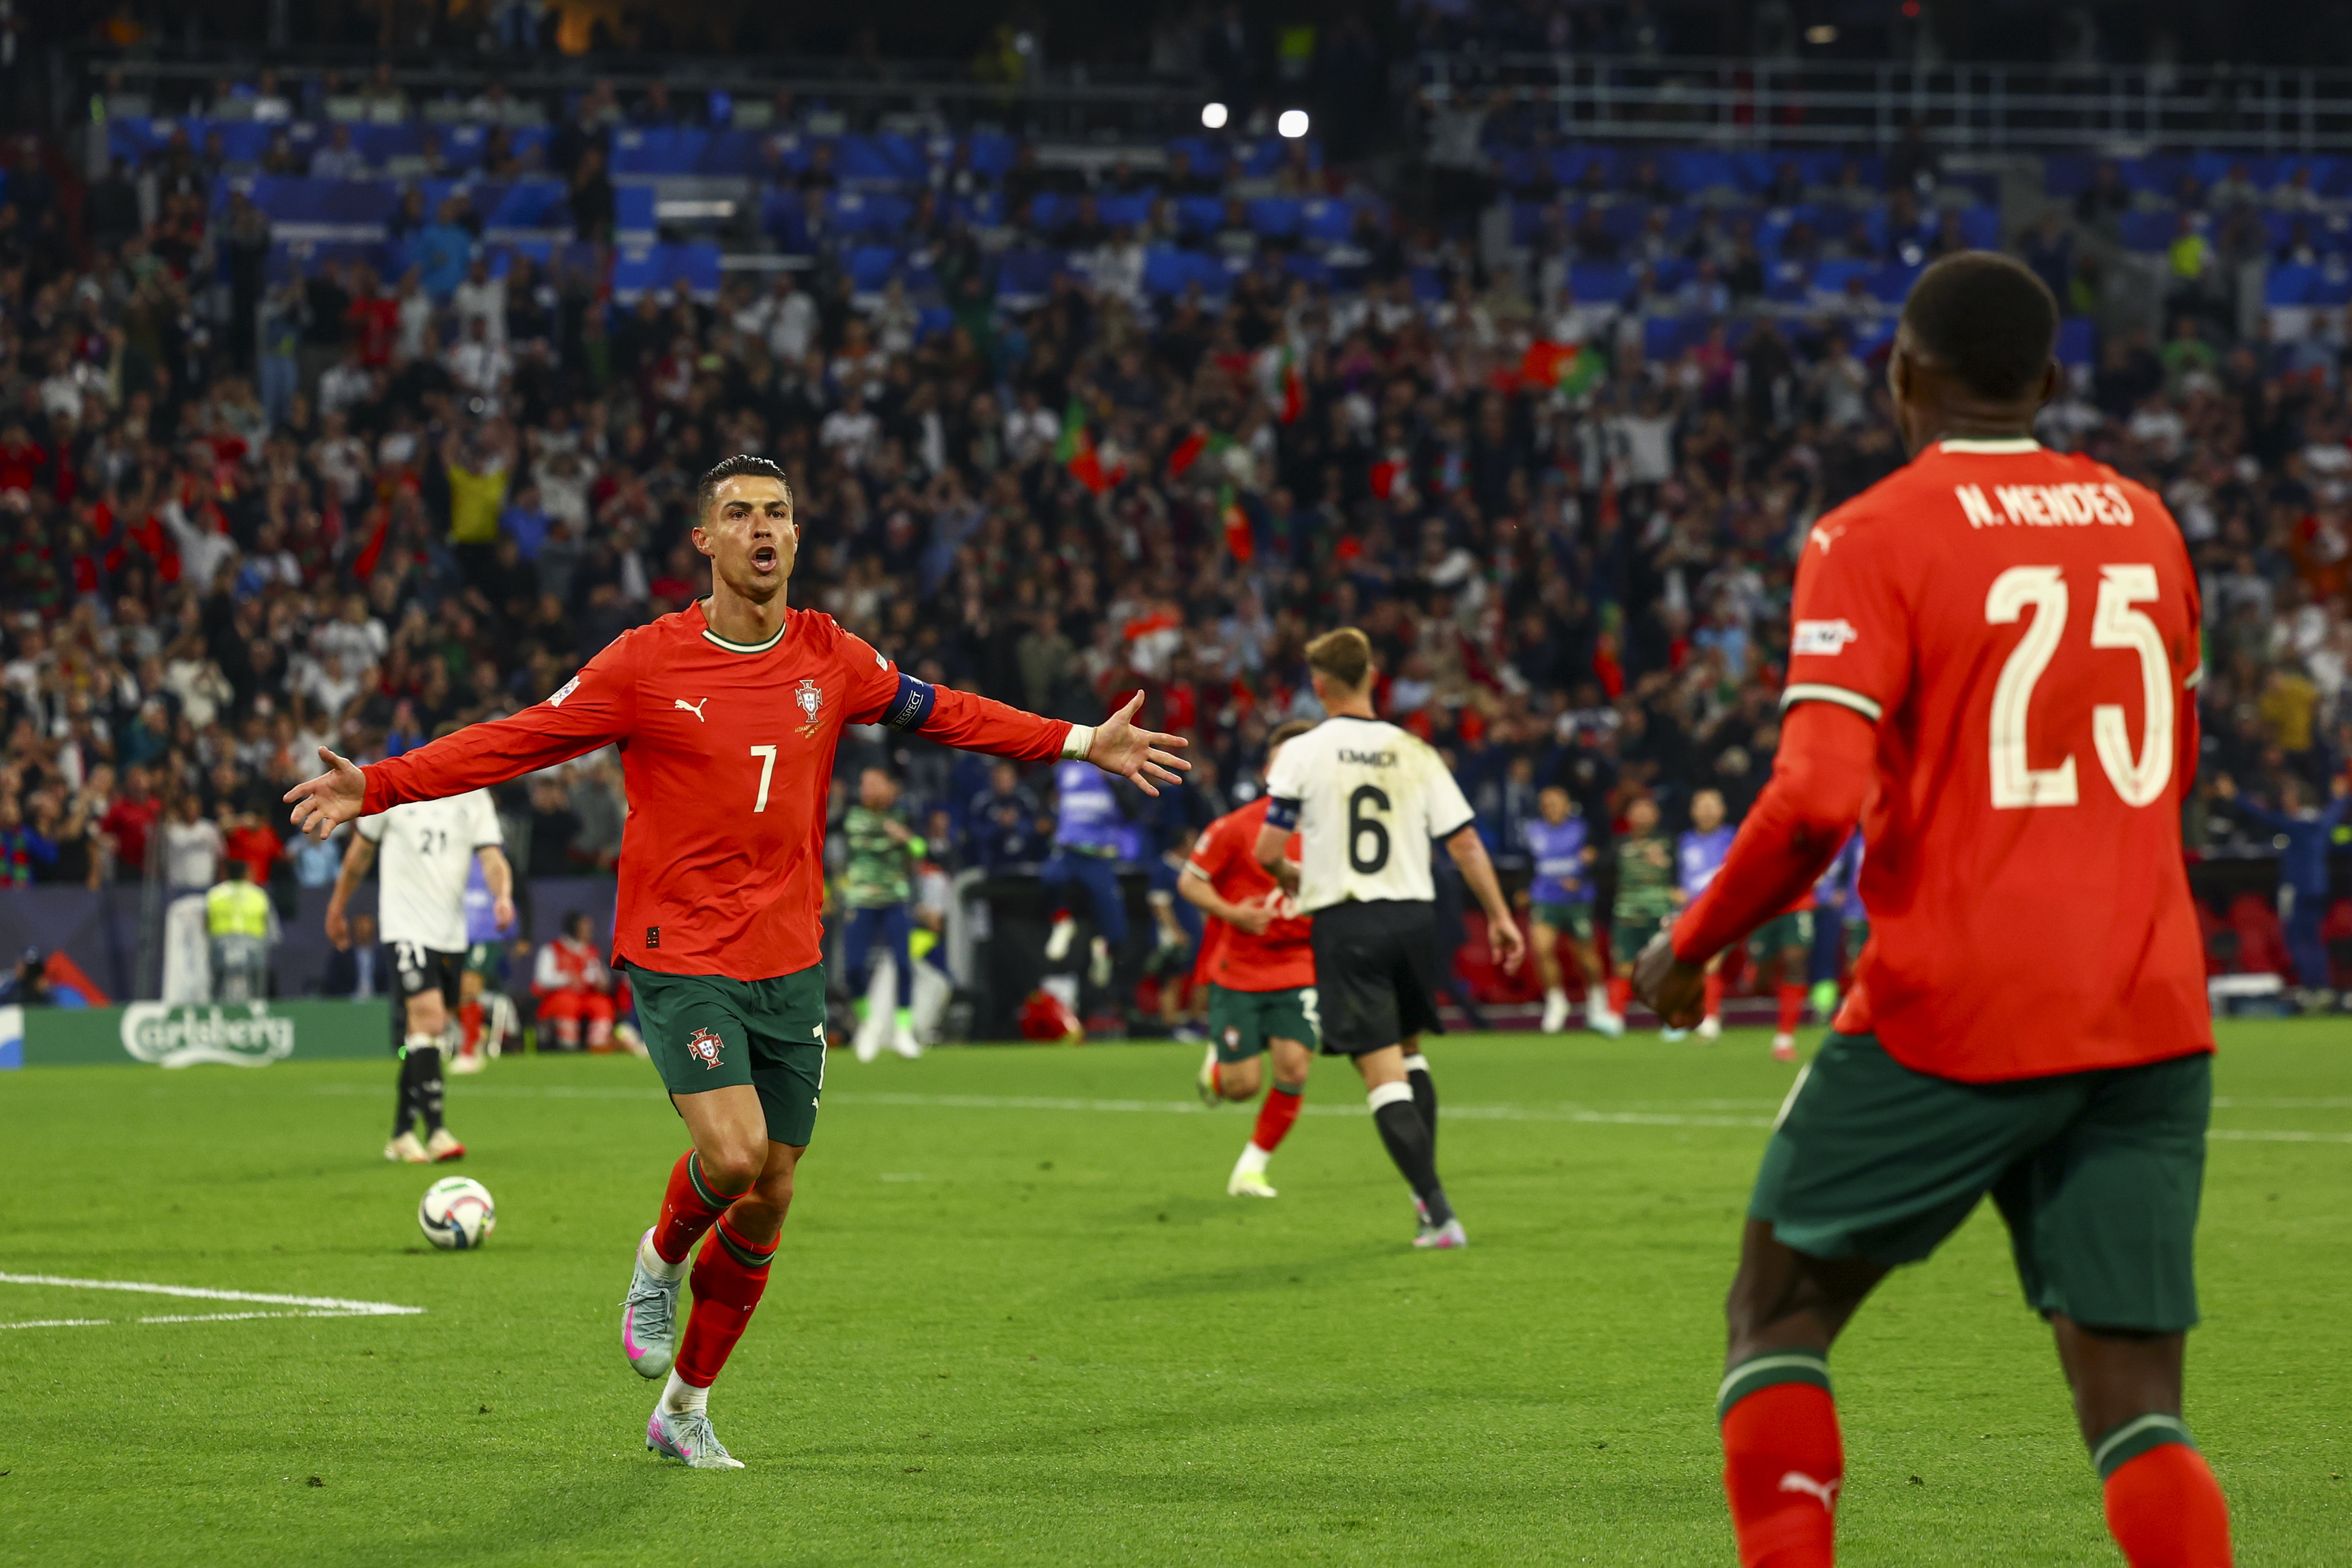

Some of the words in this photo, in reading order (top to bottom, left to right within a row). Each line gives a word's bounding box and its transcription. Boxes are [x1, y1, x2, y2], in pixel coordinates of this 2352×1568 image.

[896, 691, 921, 724] RESPECT
[1984, 563, 2174, 810] 25
[750, 744, 777, 813] 7
[421, 827, 447, 855] 21
[1349, 784, 1391, 876] 6
[121, 999, 295, 1064] Carlsberg
